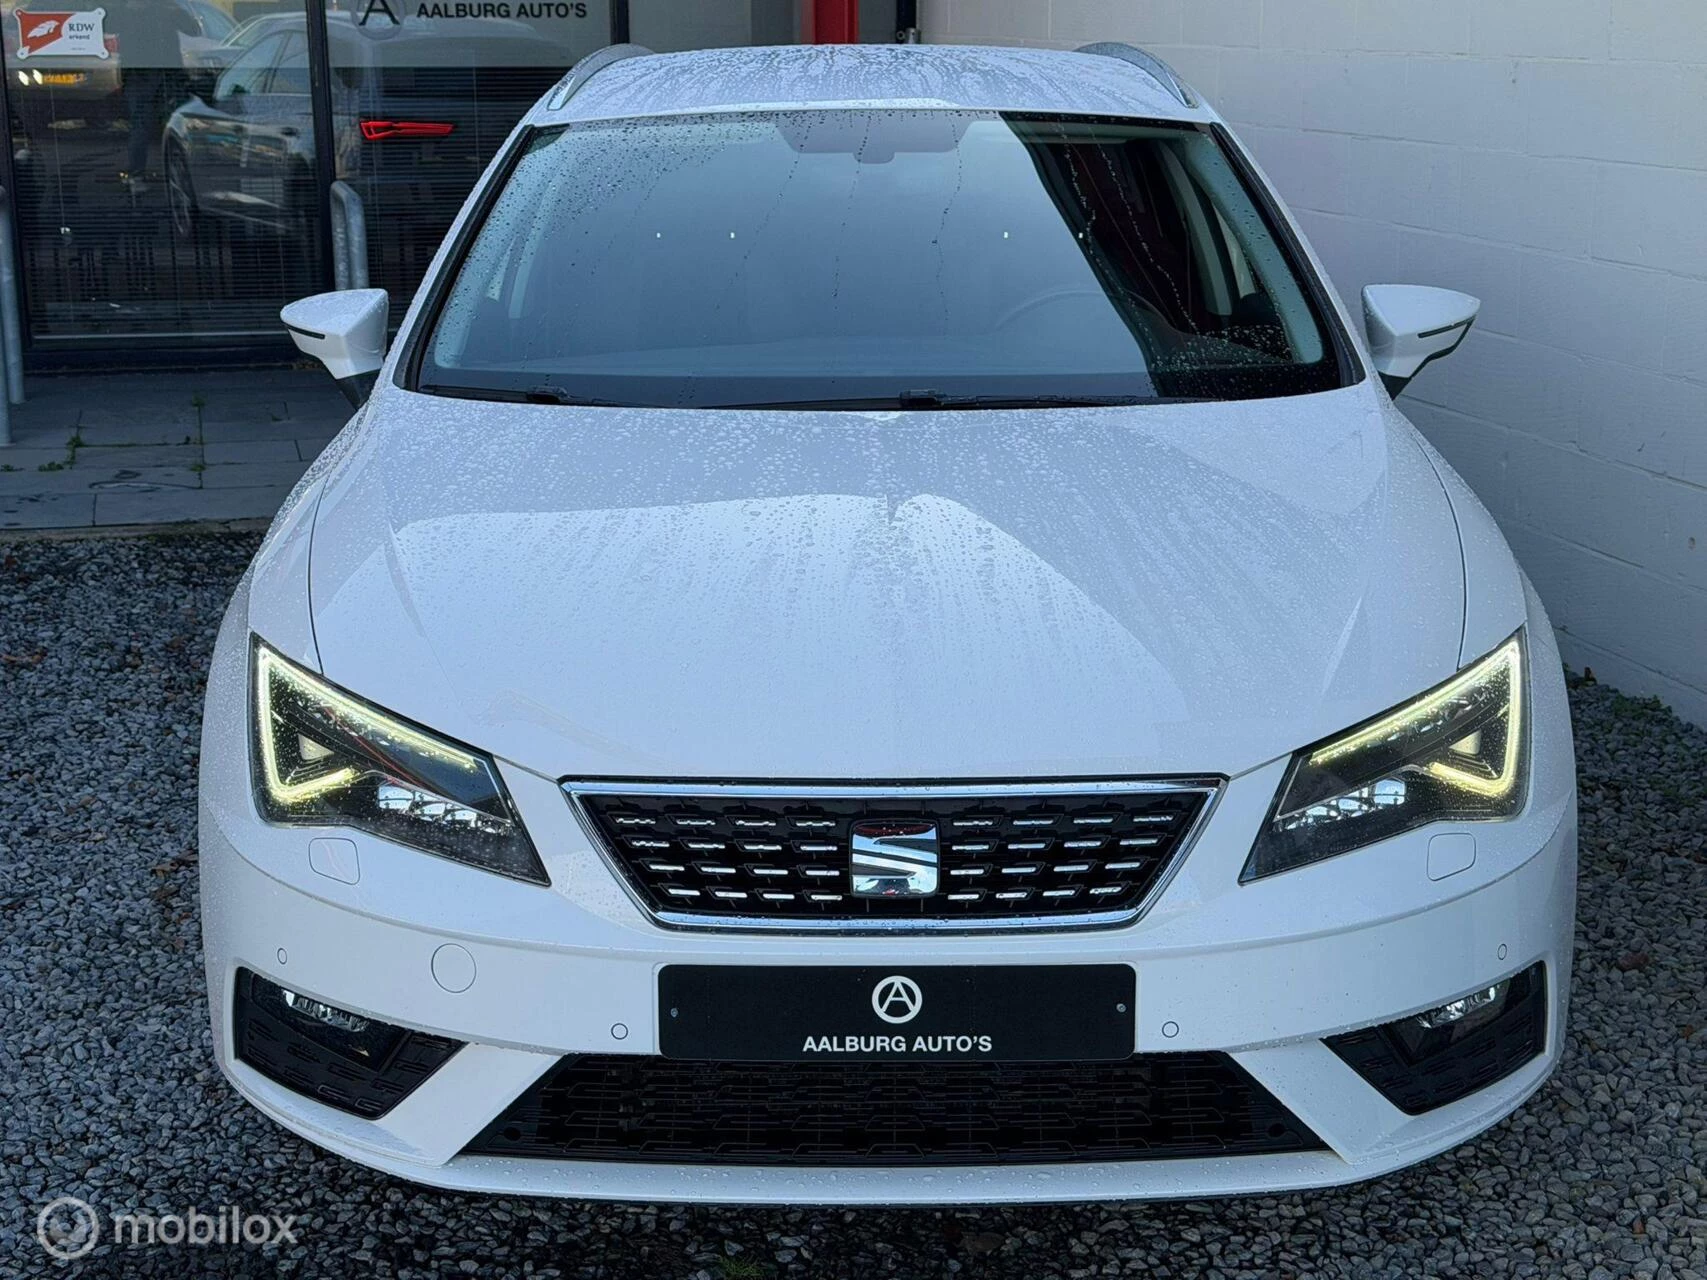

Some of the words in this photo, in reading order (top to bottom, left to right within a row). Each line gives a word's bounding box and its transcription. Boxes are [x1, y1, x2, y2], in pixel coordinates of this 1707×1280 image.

[416, 2, 511, 18] AALBURG
[516, 2, 587, 18] AUTO'S
[68, 23, 95, 32] RDW
[802, 1035, 907, 1052] AALBURG
[912, 1035, 993, 1052] AUTO'S
